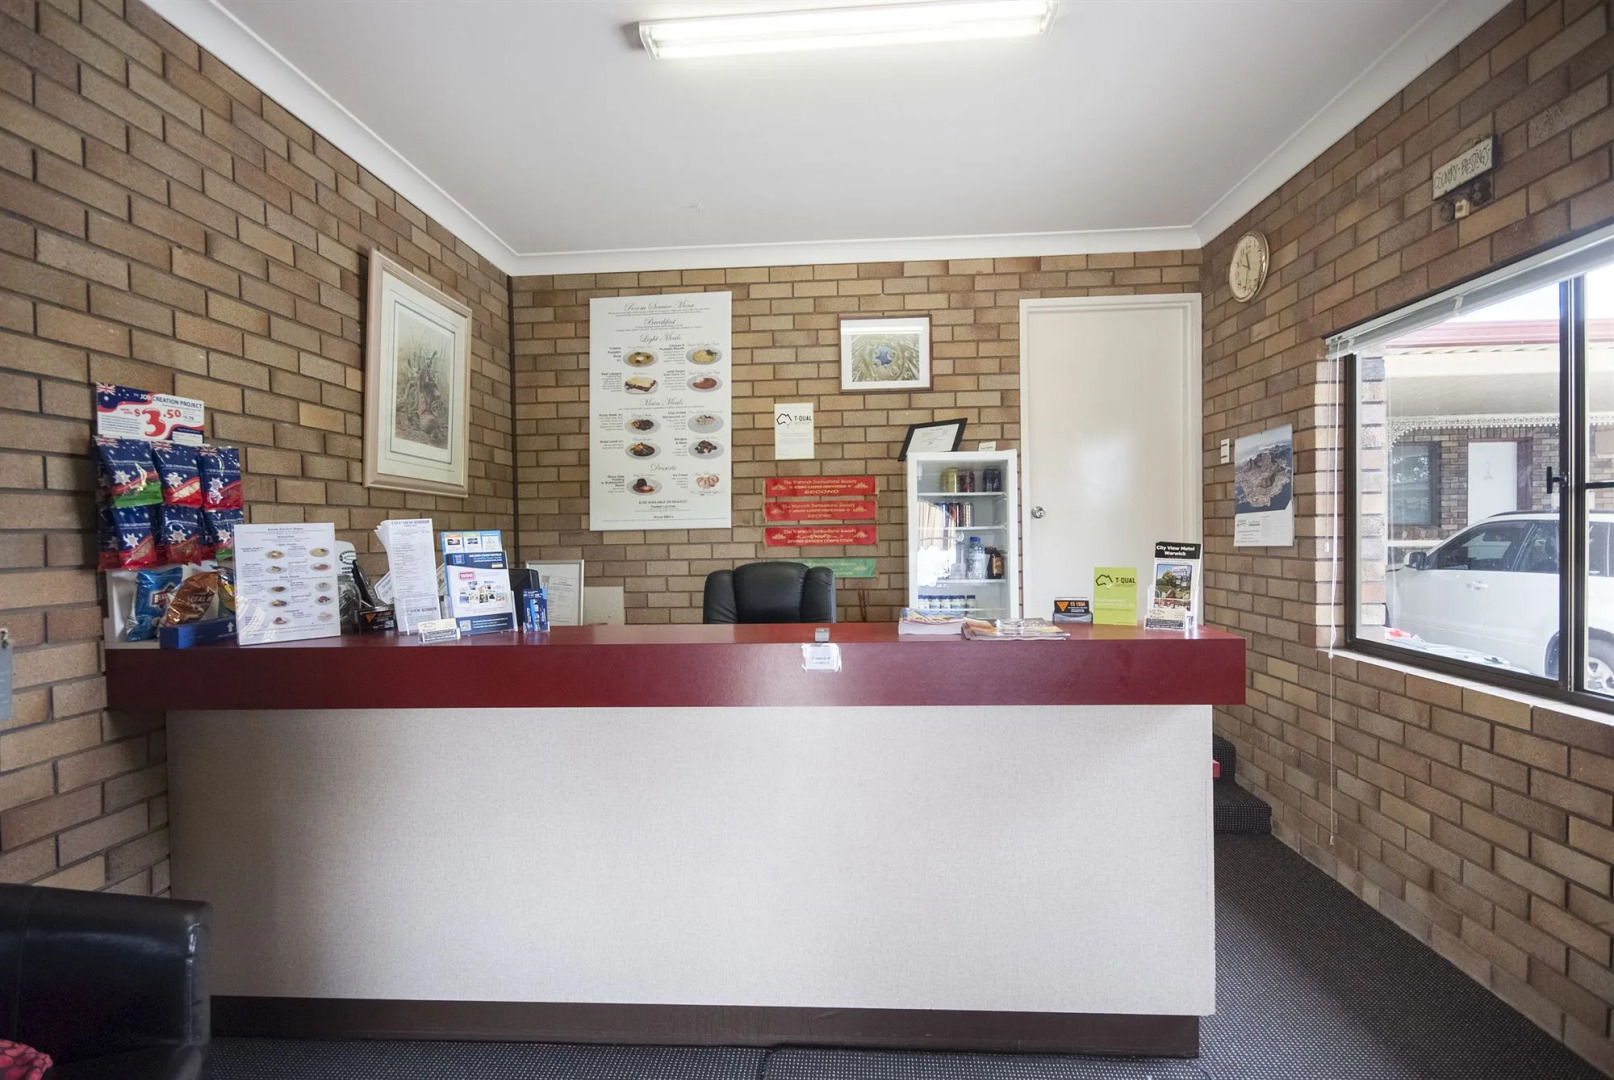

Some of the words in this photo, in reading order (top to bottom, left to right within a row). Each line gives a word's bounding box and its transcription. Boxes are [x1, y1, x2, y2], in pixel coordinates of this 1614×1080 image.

[648, 302, 672, 310] Service
[675, 300, 694, 309] Menu
[644, 317, 676, 325] Breakfast
[640, 334, 658, 344] Light
[662, 332, 681, 341] Meals
[152, 396, 179, 405] CREATION
[180, 401, 202, 409] PROJECT
[643, 397, 660, 406] Main
[664, 397, 683, 405] Meals
[651, 463, 676, 471] Desserts
